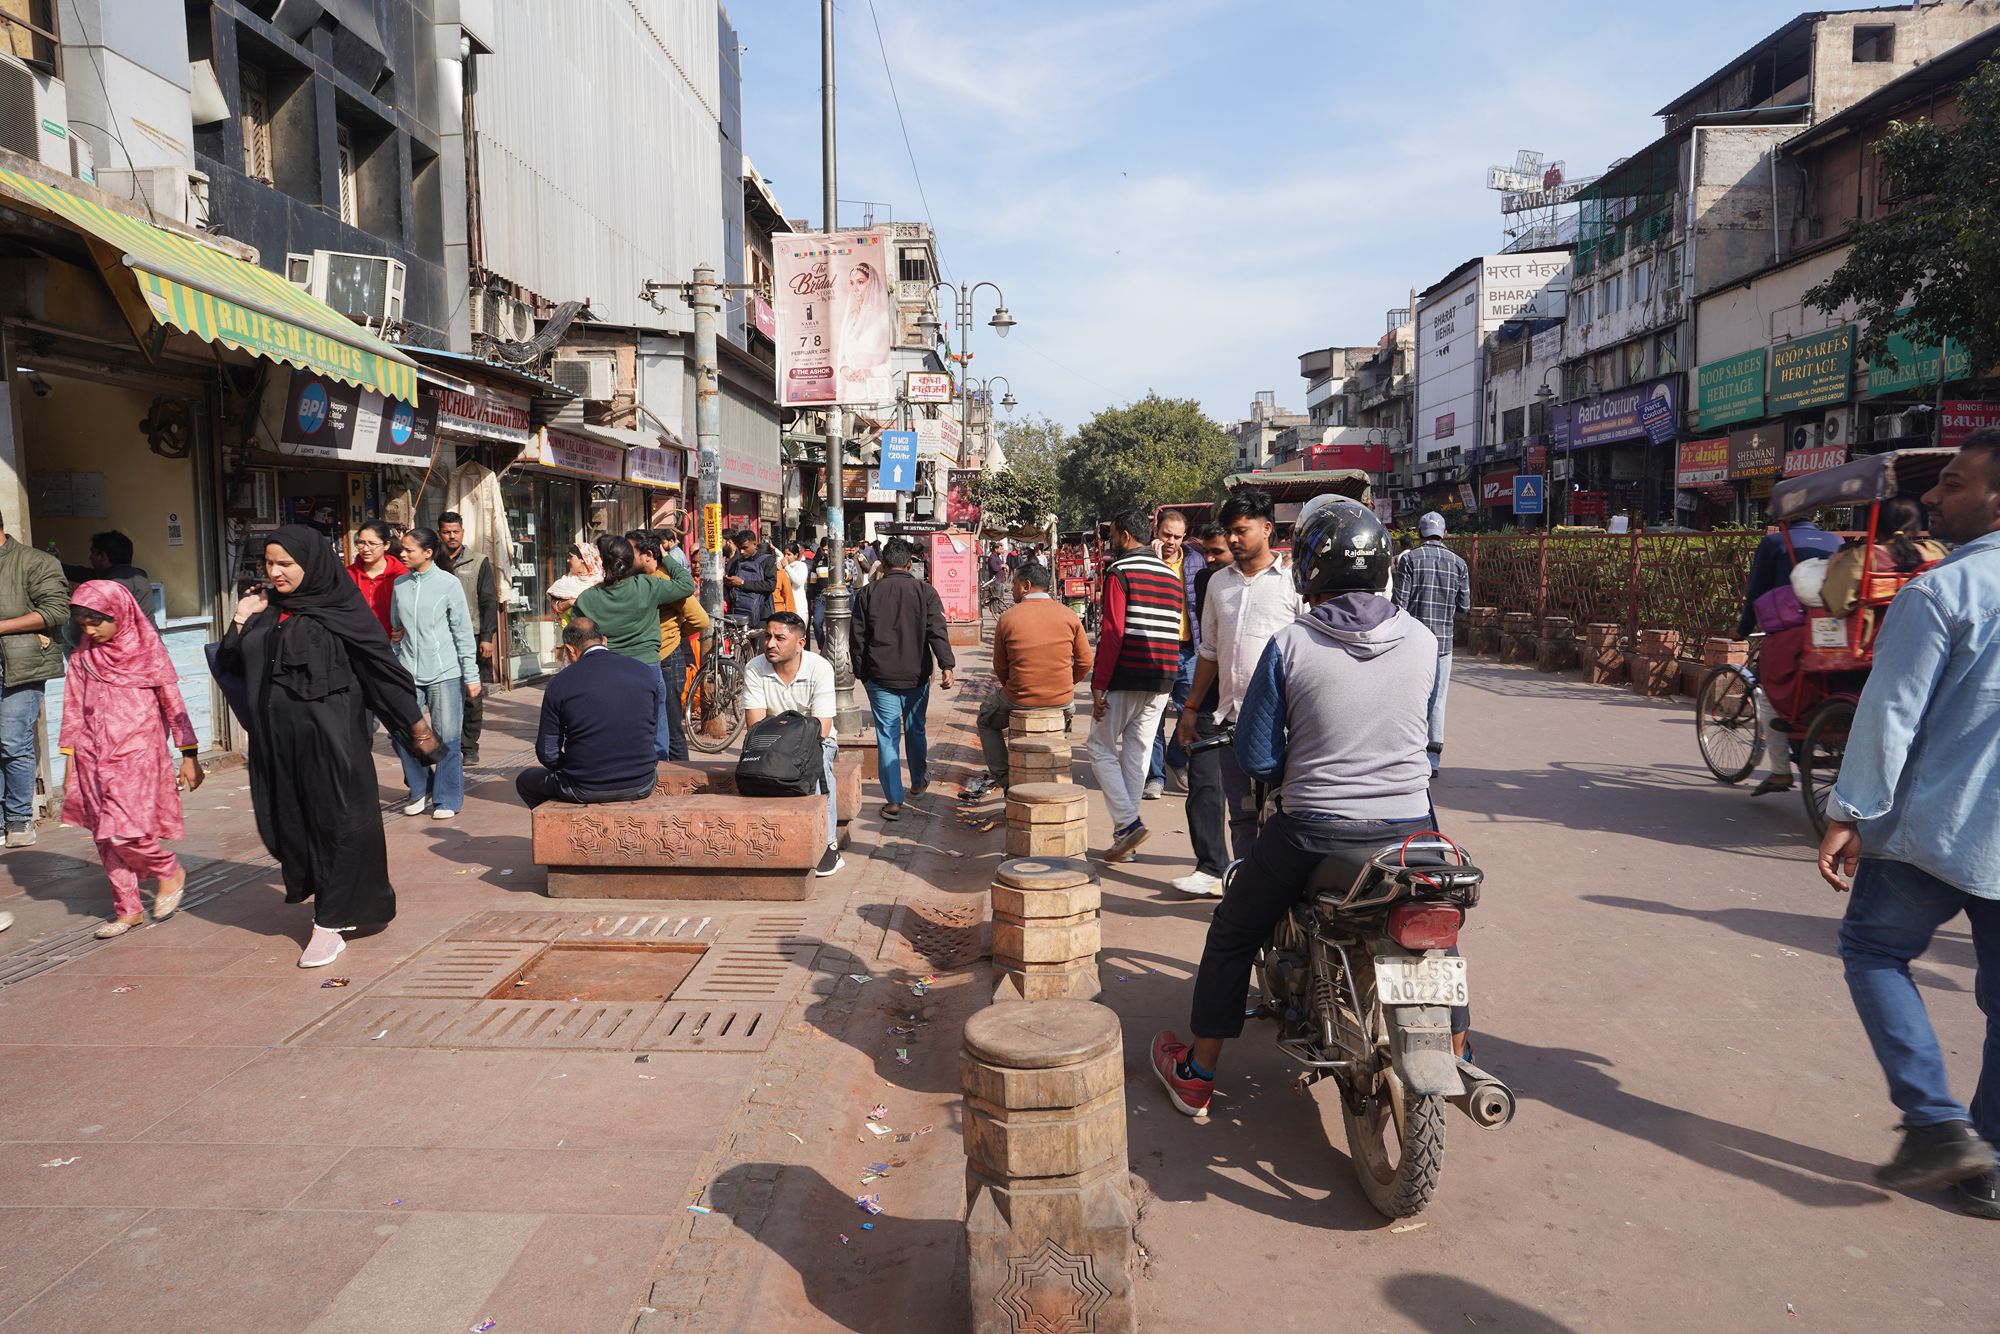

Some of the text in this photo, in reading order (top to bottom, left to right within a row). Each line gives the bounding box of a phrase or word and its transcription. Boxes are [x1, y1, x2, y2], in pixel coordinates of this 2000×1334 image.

[811, 262, 829, 275] The
[1486, 259, 1566, 279] भरत मेहरा
[788, 272, 838, 295] Bridal
[1489, 289, 1540, 302] BHARAT
[1492, 303, 1537, 315] MEHRA
[1433, 306, 1457, 329] BHARAT
[217, 301, 363, 373] RAJESH FOODS
[1435, 322, 1455, 342] MEHRA
[800, 335, 822, 347] 7 8
[1775, 348, 1803, 367] ROOP
[1805, 335, 1849, 360] SAREES
[809, 367, 830, 375] ASHOK
[1700, 355, 1761, 387] ROOP SAREES
[1781, 357, 1838, 383] HERITAGE
[1871, 350, 1972, 388] WHOLESALE PICES
[1707, 377, 1753, 403] HERITAGE
[299, 397, 326, 420] BPL
[329, 401, 348, 413] Happy
[1578, 395, 1640, 424] Aariz Couture
[1642, 406, 1667, 420] Couture
[1644, 402, 1661, 413] Aariz
[1956, 404, 1983, 412] SINCE
[328, 419, 345, 431] Things
[392, 414, 412, 431] BPL
[490, 404, 530, 430] BROTHERS
[413, 431, 428, 442] Things
[887, 452, 911, 460] ₹20/hr
[889, 444, 909, 452] PARKING
[1737, 447, 1776, 463] SHERWANI
[1755, 458, 1775, 467] STUDIO
[1785, 449, 1846, 473] BALUJAS
[1483, 482, 1500, 499] VIP
[1344, 548, 1375, 558] Rajdhani
